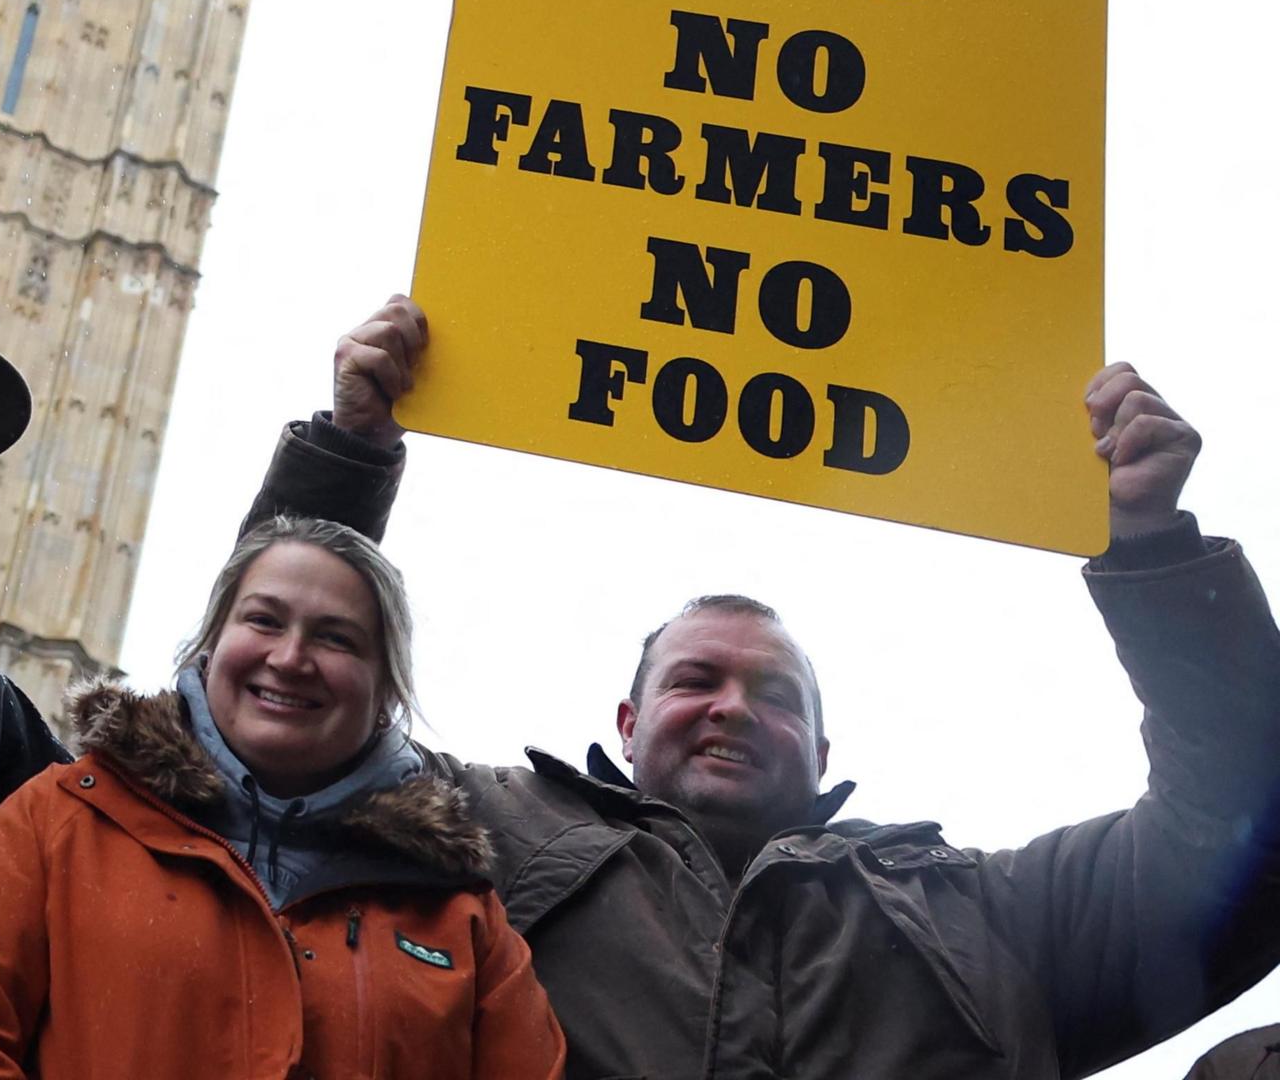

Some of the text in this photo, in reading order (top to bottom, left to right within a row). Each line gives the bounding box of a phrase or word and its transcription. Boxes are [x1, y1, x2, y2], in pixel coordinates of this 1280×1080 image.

[663, 9, 866, 114] NO
[455, 85, 1075, 259] FARMERS
[639, 236, 852, 350] NO
[567, 338, 911, 476] FOOD
